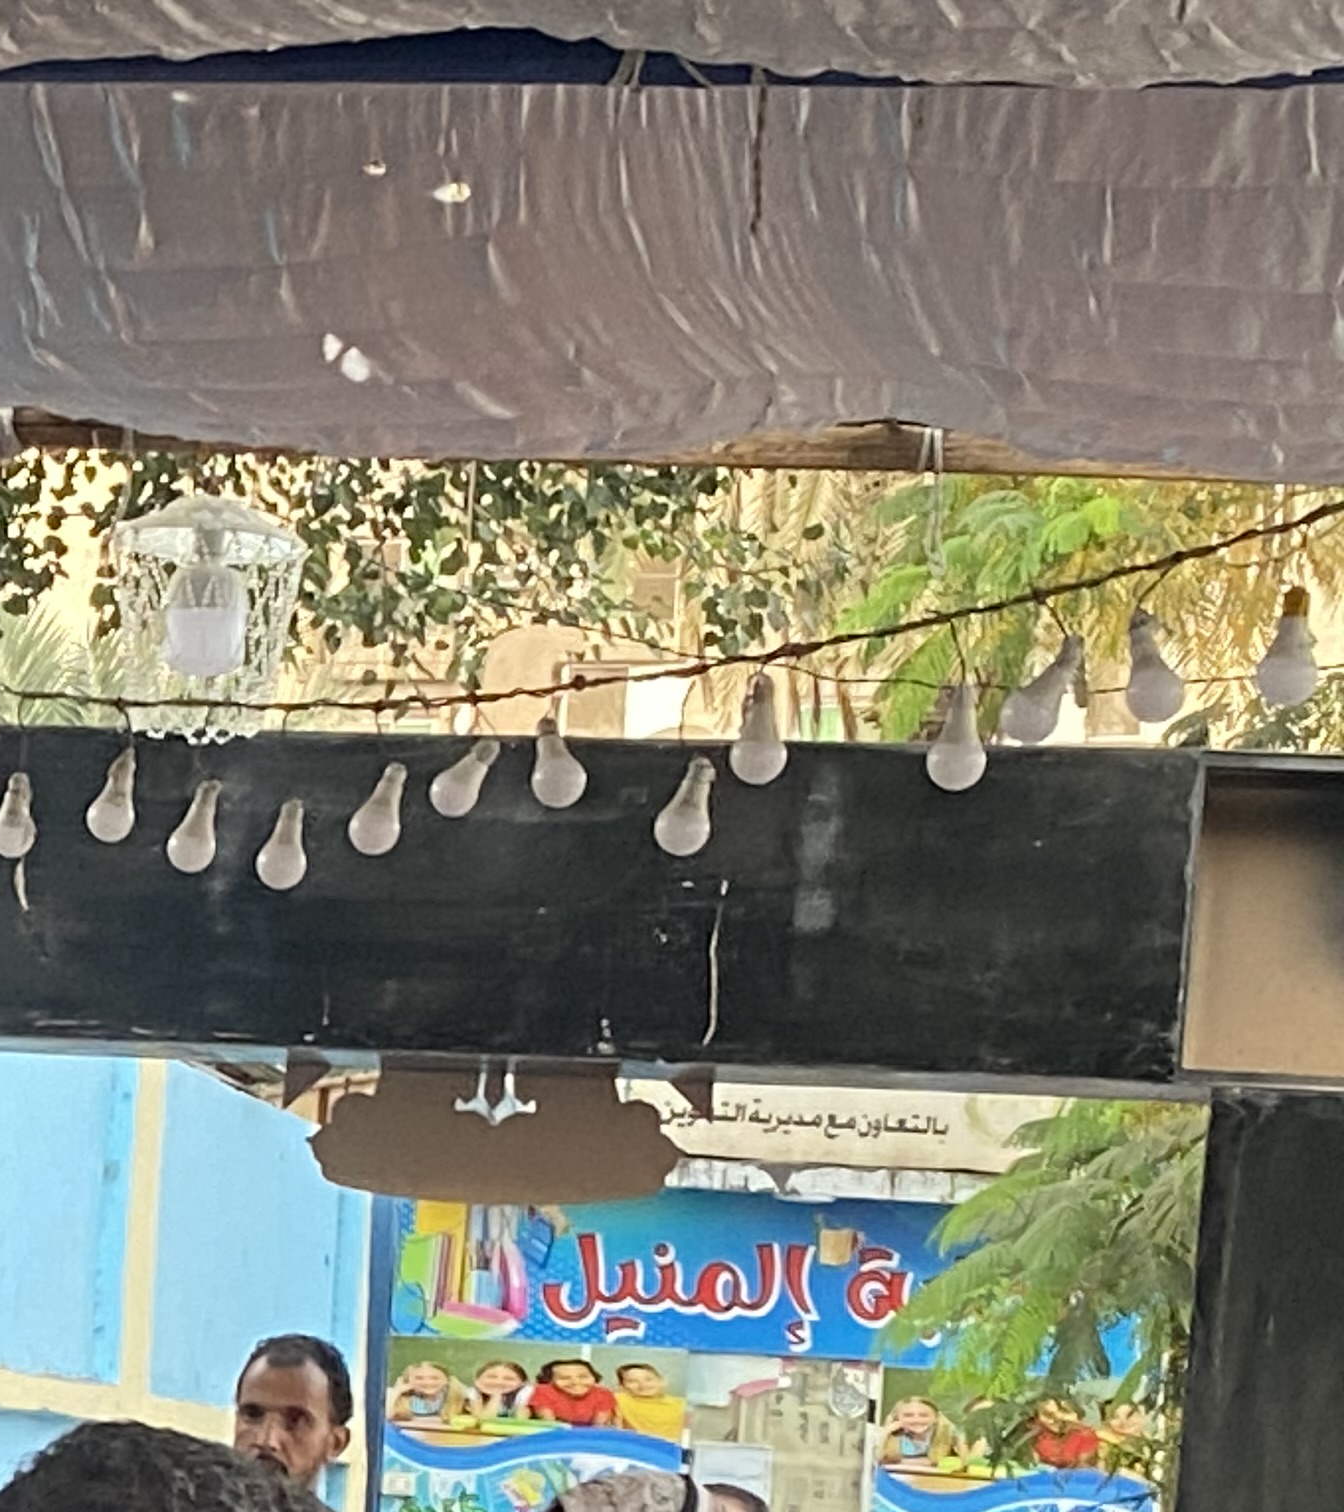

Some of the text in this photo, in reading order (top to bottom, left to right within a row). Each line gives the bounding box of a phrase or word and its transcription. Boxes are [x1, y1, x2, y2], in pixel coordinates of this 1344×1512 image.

[748, 1098, 823, 1133] مديرية
[823, 1113, 857, 1139] مع
[858, 1112, 949, 1144] بالتعاون
